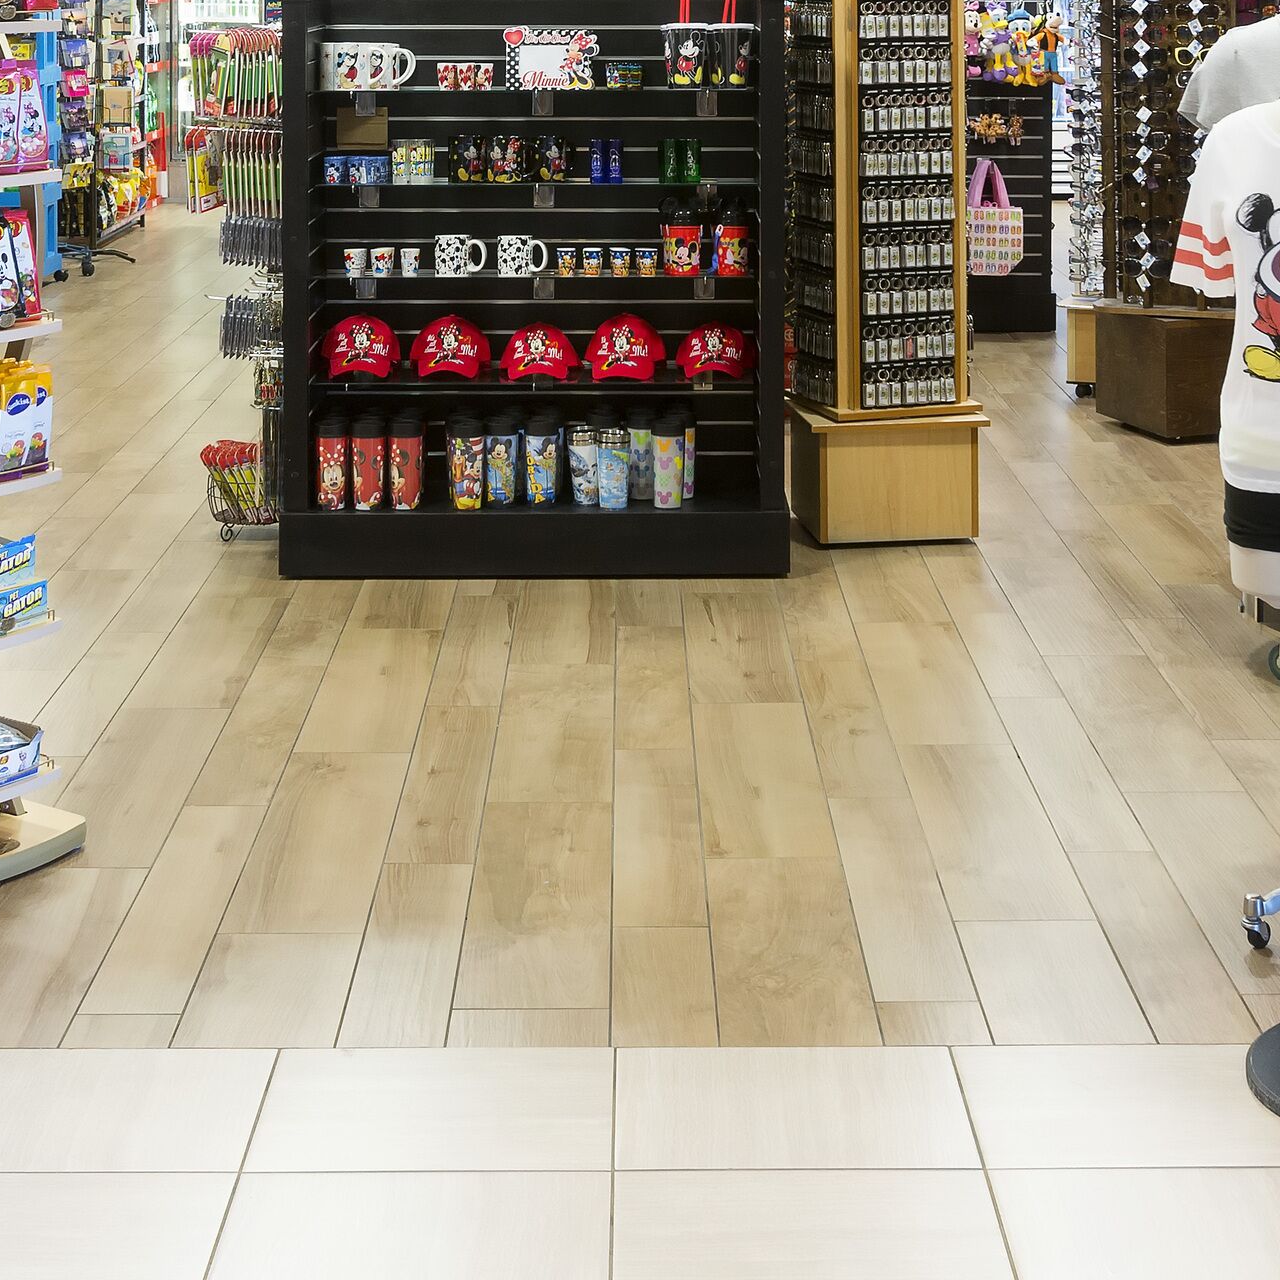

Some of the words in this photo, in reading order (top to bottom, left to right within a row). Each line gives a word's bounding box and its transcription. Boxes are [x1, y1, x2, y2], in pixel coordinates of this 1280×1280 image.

[523, 71, 568, 90] Minnie
[7, 397, 30, 413] Sunkist
[3, 586, 43, 619] GATOR
[9, 591, 19, 601] PET
